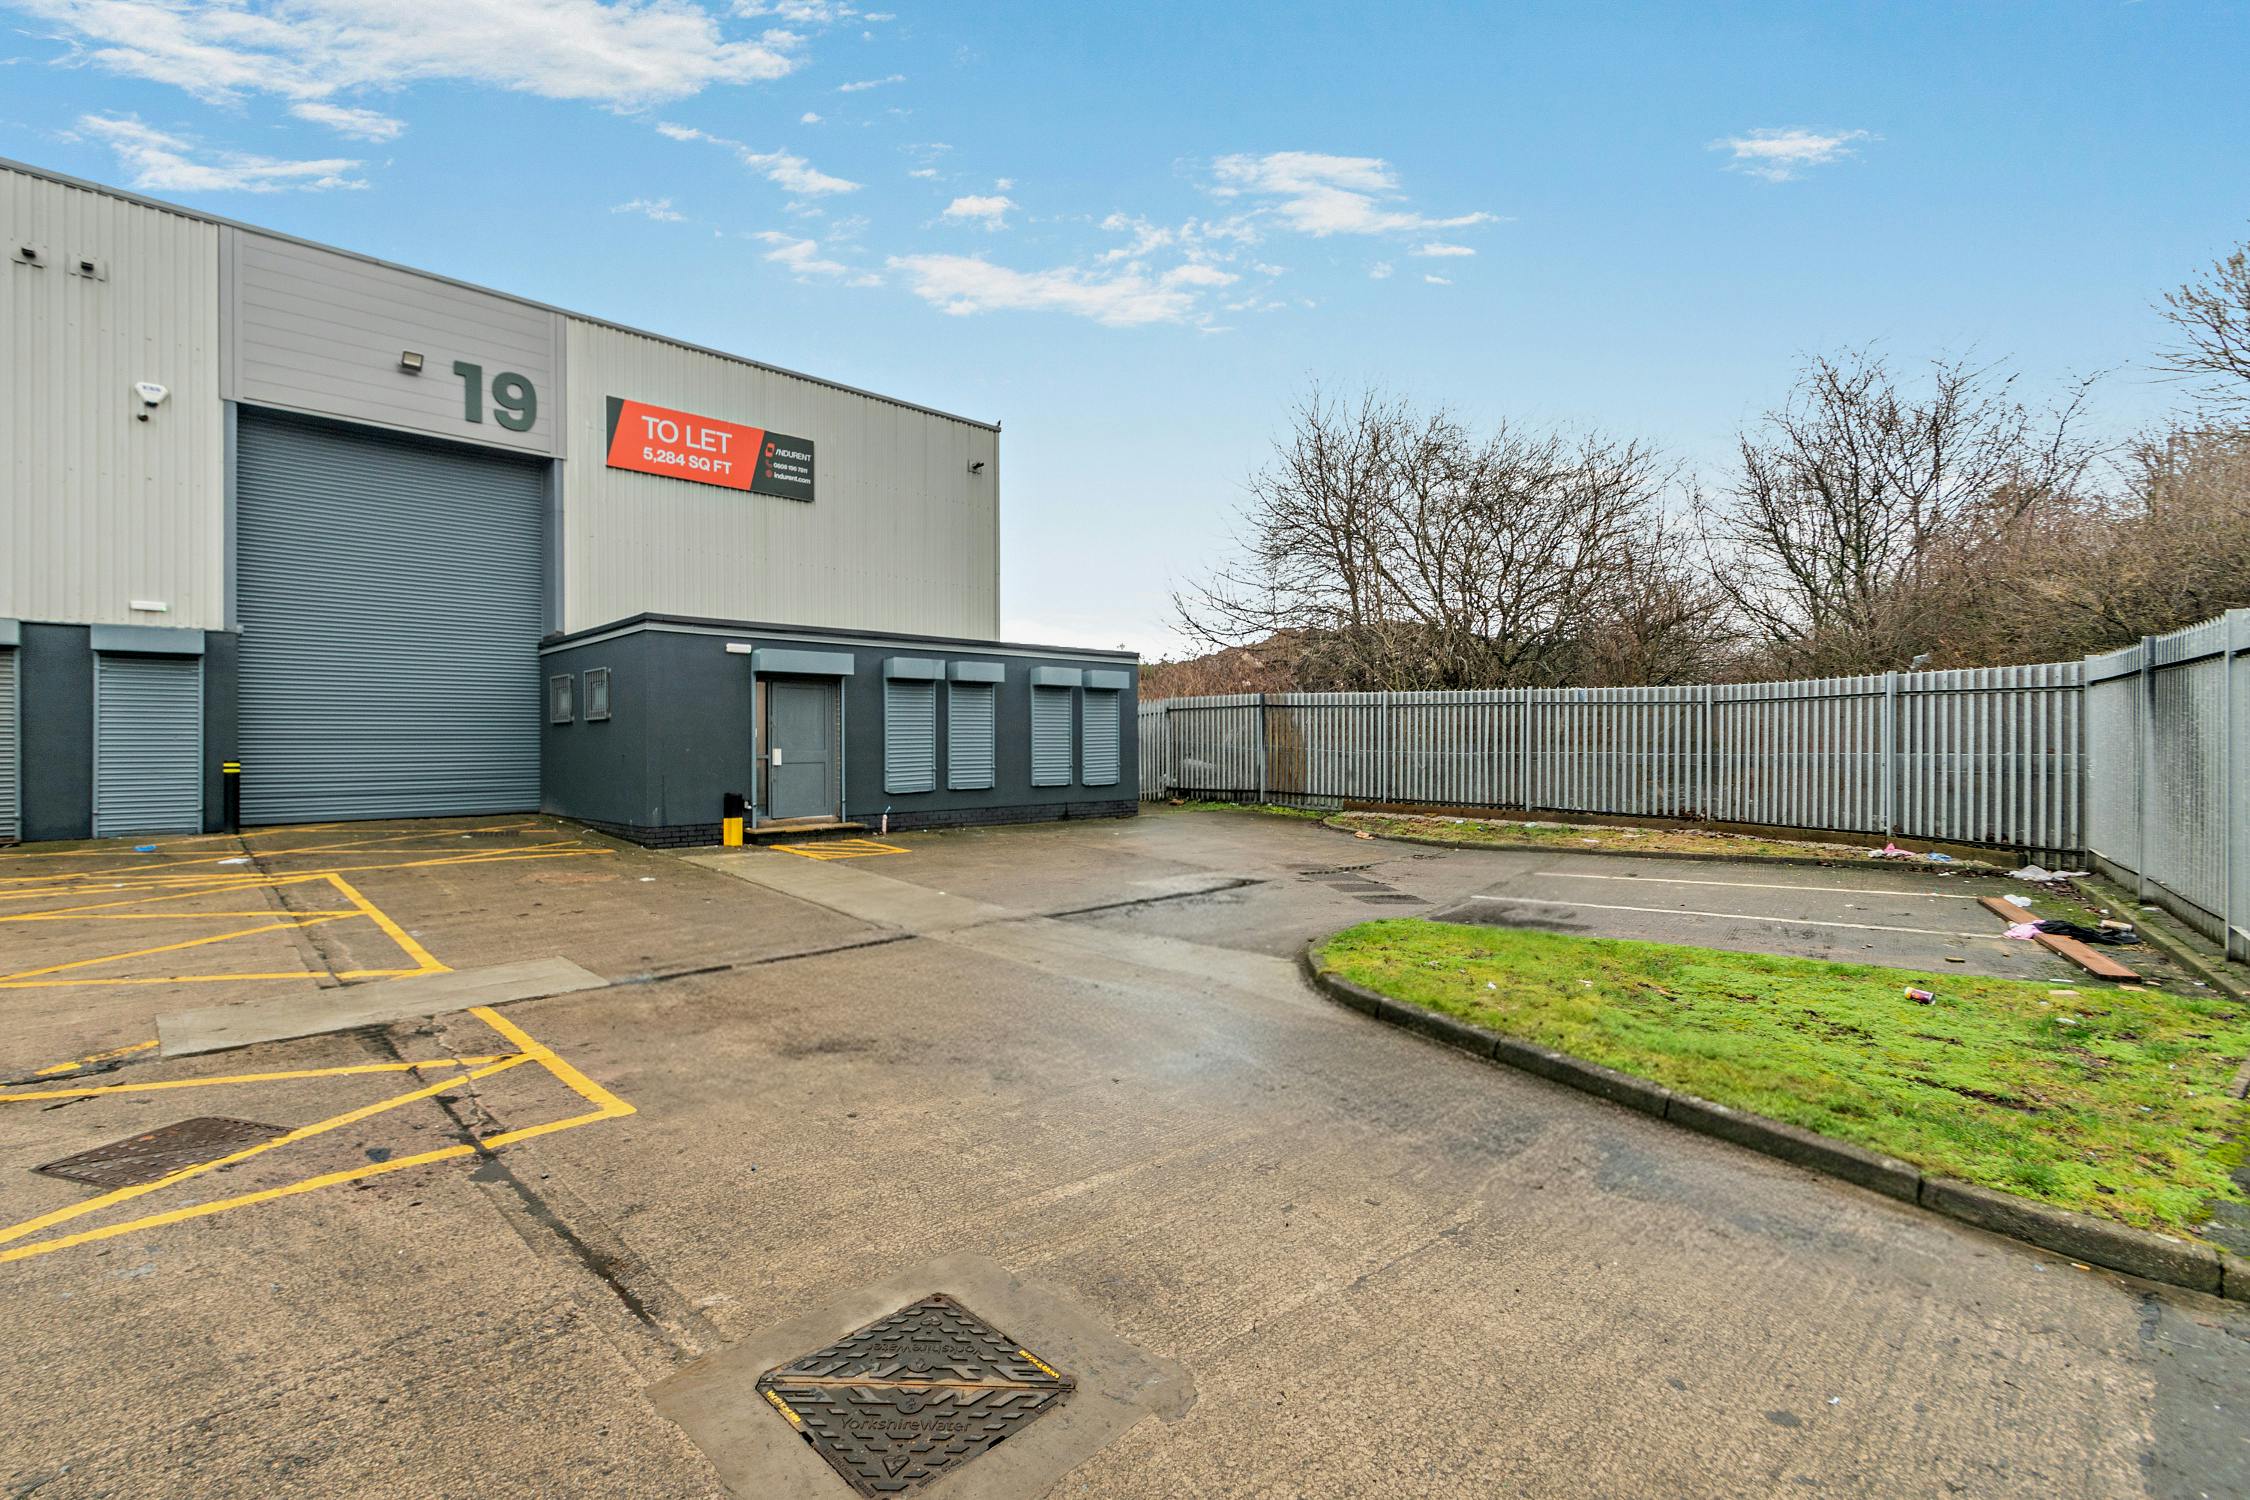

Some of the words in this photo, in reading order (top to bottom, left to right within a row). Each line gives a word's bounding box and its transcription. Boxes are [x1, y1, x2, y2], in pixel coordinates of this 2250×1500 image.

[453, 360, 537, 432] 19
[641, 415, 679, 444] TO
[686, 424, 732, 454] LET
[643, 446, 685, 467] 5,284
[688, 455, 711, 472] SQ
[713, 459, 732, 475] FT
